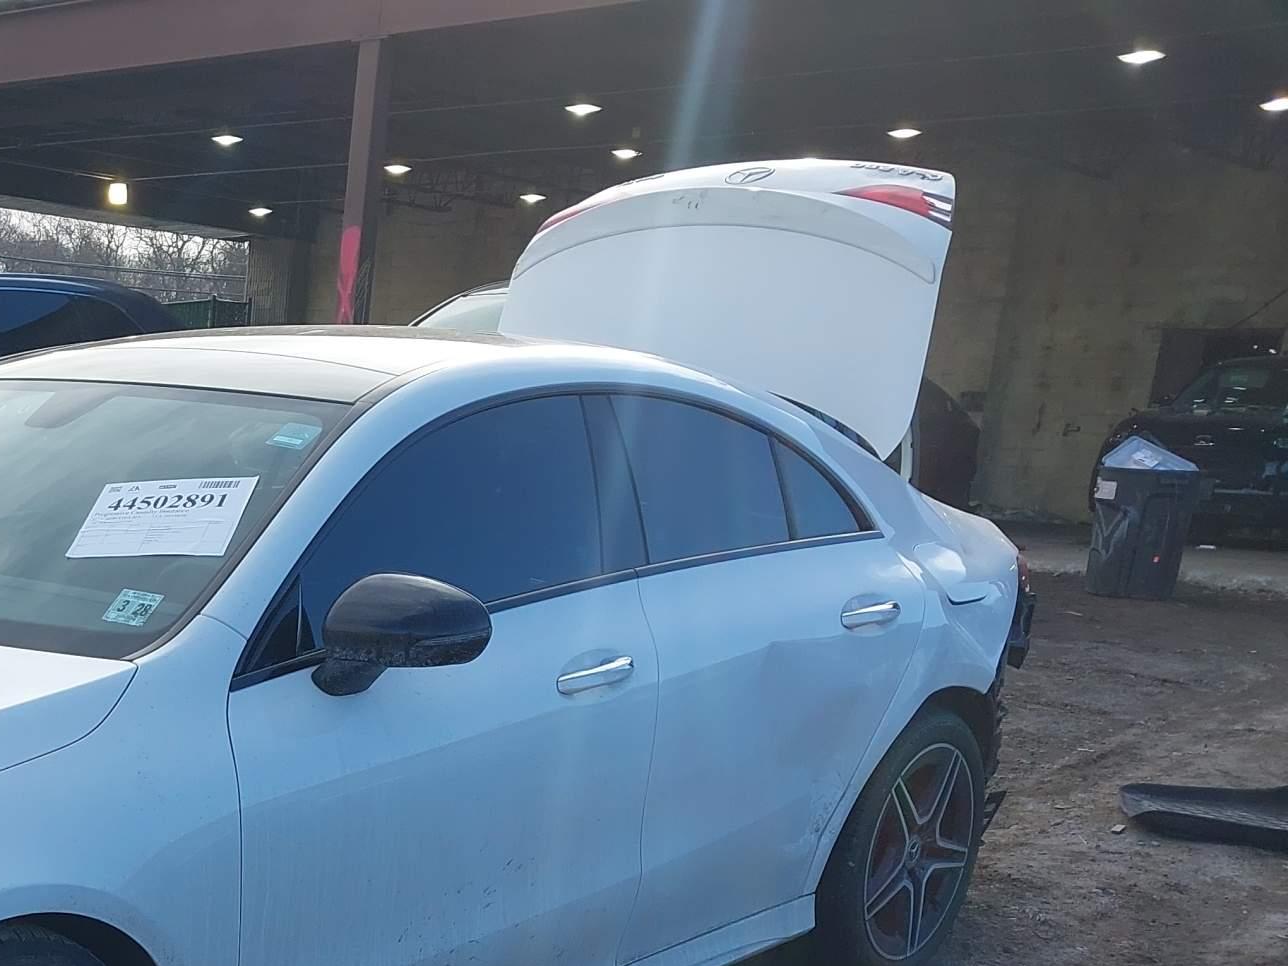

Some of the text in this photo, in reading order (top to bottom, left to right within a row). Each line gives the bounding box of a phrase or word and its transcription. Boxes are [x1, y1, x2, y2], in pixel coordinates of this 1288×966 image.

[108, 493, 228, 511] 44502891
[117, 599, 153, 617] 3 28
